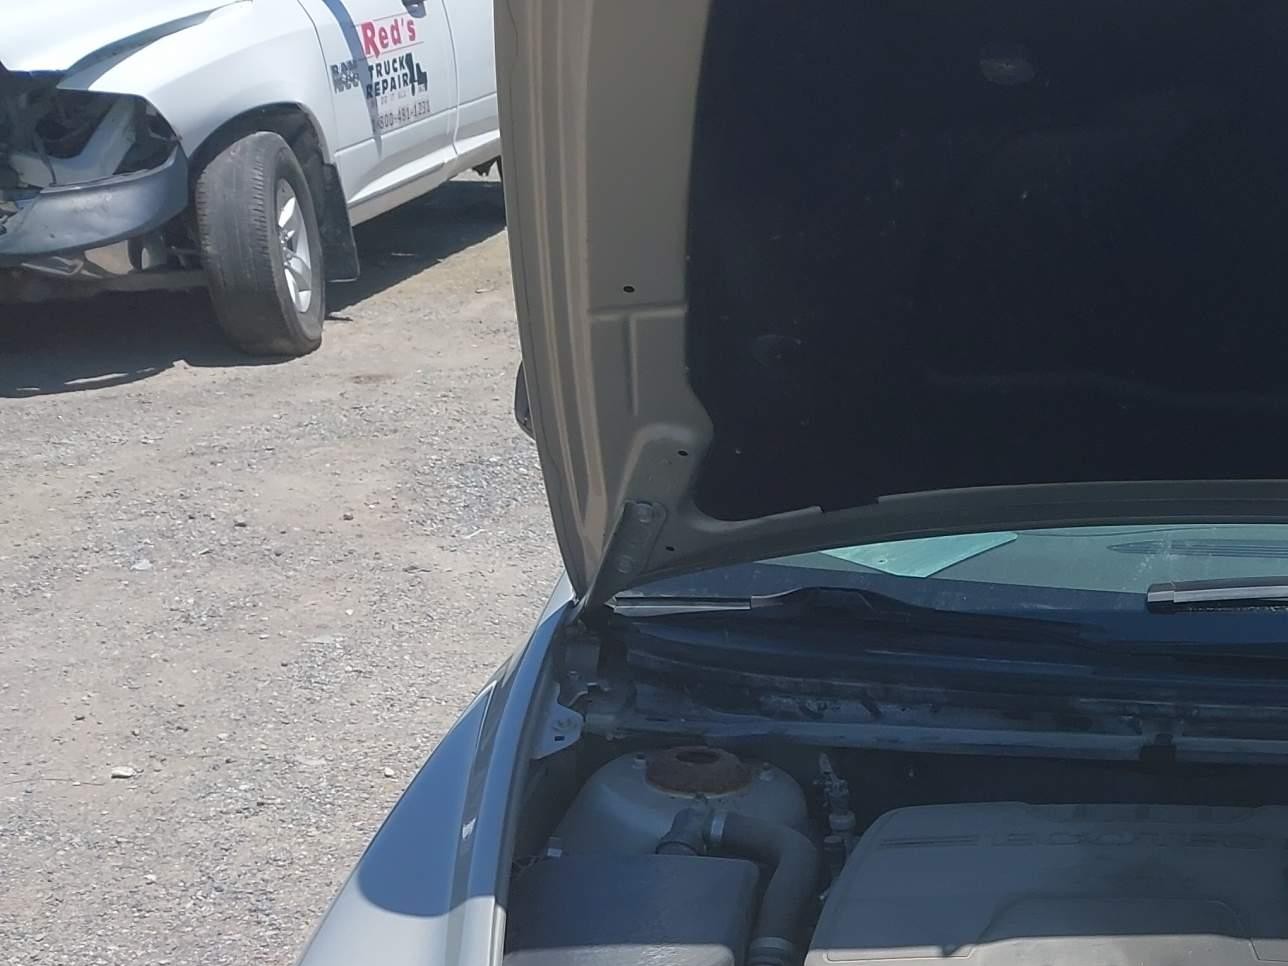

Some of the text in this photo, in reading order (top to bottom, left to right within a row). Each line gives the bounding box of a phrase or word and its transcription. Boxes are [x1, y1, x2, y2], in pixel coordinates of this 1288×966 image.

[361, 18, 417, 58] Red's
[367, 55, 406, 80] TRUCK
[366, 72, 409, 99] REPAIR
